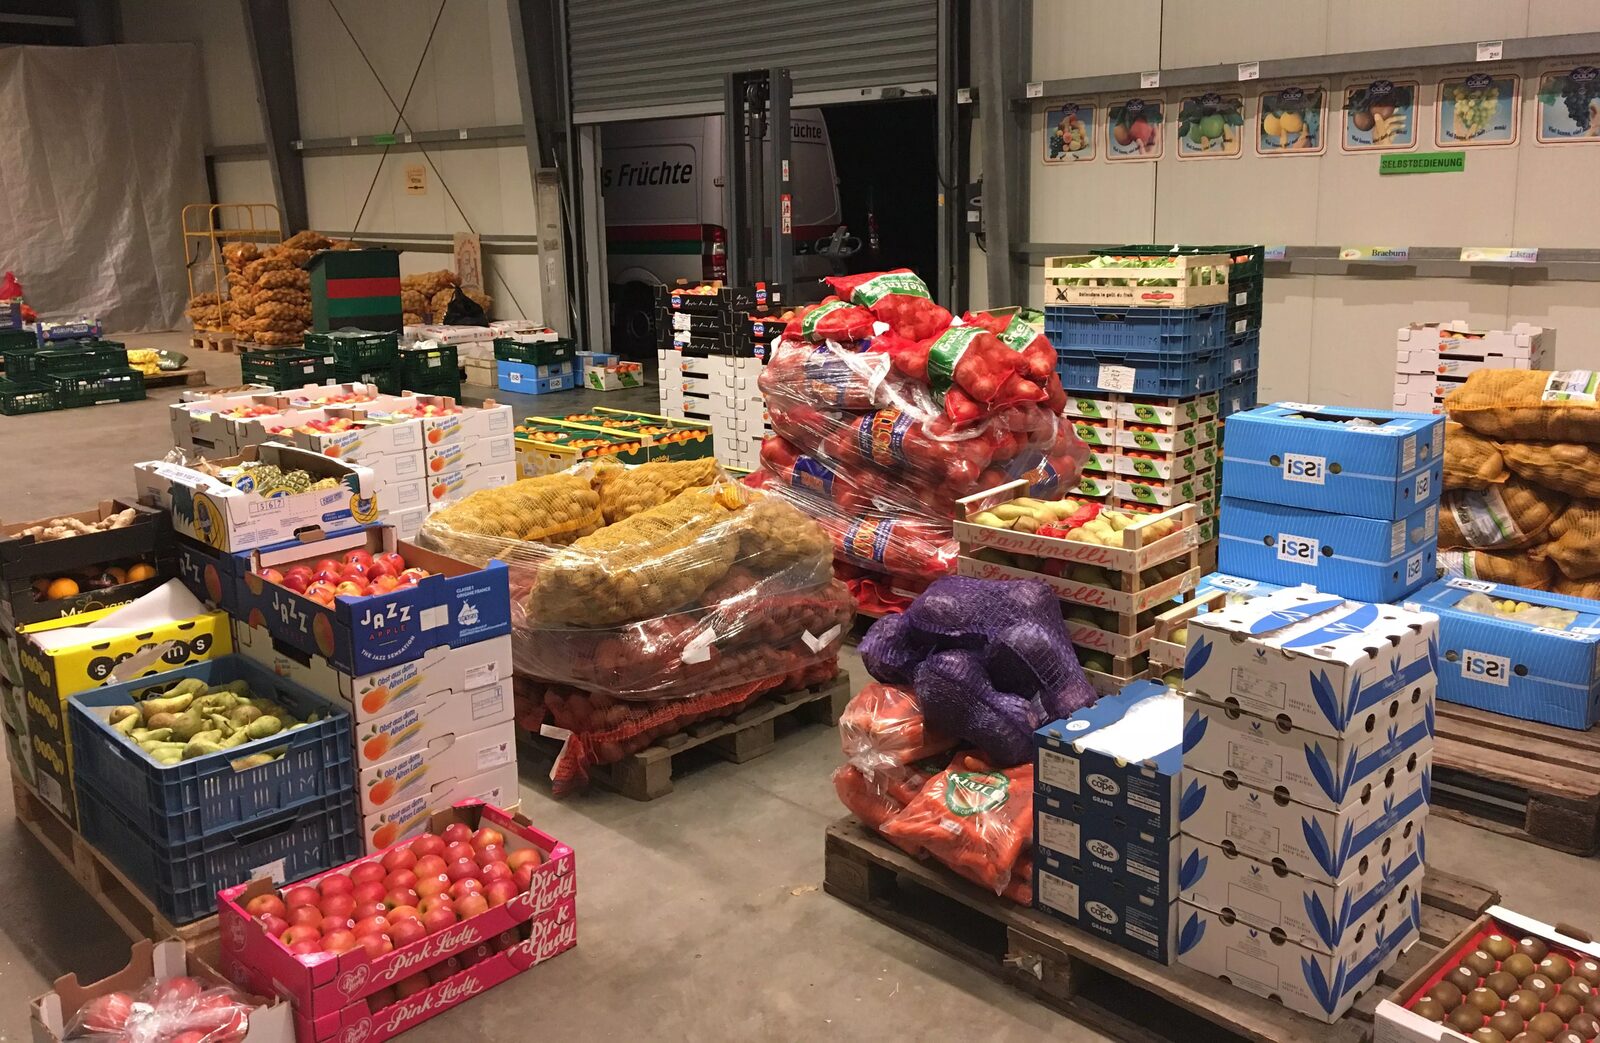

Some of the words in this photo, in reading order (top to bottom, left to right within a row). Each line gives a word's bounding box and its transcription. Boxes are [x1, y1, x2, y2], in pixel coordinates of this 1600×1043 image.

[793, 122, 822, 140] rüchte
[1382, 157, 1463, 168] SELBSTBEDIENUNG
[617, 161, 693, 188] Früchte
[1371, 248, 1406, 258] Braeburn
[974, 527, 1113, 566] Fantinelli
[474, 586, 490, 594] FRANCE
[272, 591, 308, 633] JAZZ
[360, 602, 411, 630] JAZZ
[370, 624, 406, 640] APPLE
[361, 648, 371, 658] THE
[388, 635, 416, 660] SENSATION
[378, 674, 390, 686] Obst
[390, 669, 402, 679] aus
[402, 664, 414, 674] dem
[404, 667, 418, 680] Land
[380, 722, 392, 733] Obst
[392, 716, 402, 726] aus
[403, 710, 416, 720] dem
[405, 712, 418, 727] Land
[1092, 779, 1114, 794] cape
[1092, 796, 1114, 808] GRAPES
[1092, 845, 1114, 859] cape
[1092, 860, 1112, 874] GRAPES
[522, 858, 570, 908] Pink
[530, 874, 576, 918] Lady
[1090, 907, 1112, 922] cape
[522, 906, 570, 956] Pink
[1092, 922, 1112, 935] GRAPES
[373, 940, 432, 981] Pink
[432, 925, 479, 956] Lady
[530, 921, 576, 967] Lady
[374, 992, 434, 1036] Pink
[434, 976, 481, 1008] Lady
